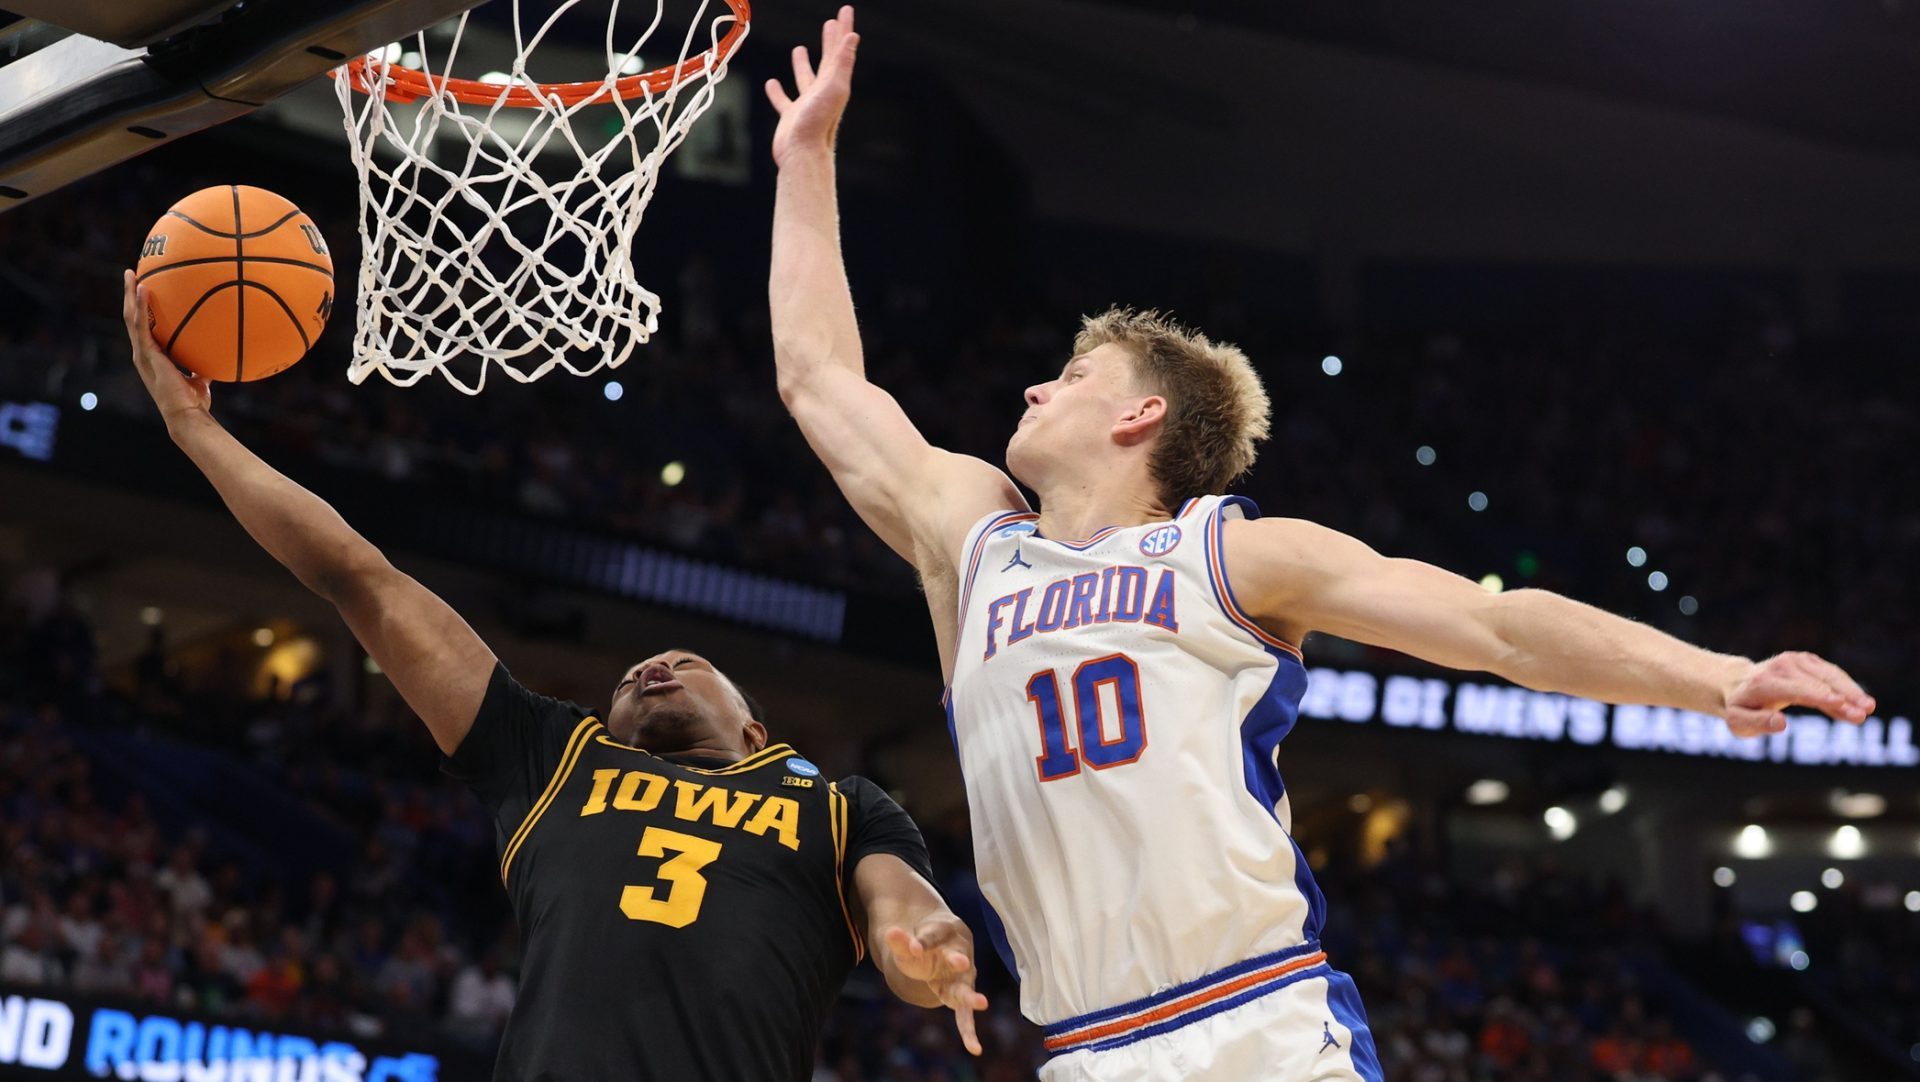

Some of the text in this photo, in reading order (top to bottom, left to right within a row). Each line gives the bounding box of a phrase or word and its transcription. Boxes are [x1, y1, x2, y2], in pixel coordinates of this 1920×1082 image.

[1142, 526, 1180, 554] SEC
[984, 565, 1179, 661] FLORIDA
[1026, 652, 1148, 782] 10
[1453, 682, 1607, 745] MEN'S
[580, 769, 800, 851] IOWA
[619, 826, 722, 929] 3
[85, 1008, 366, 1082] ROUNDS
